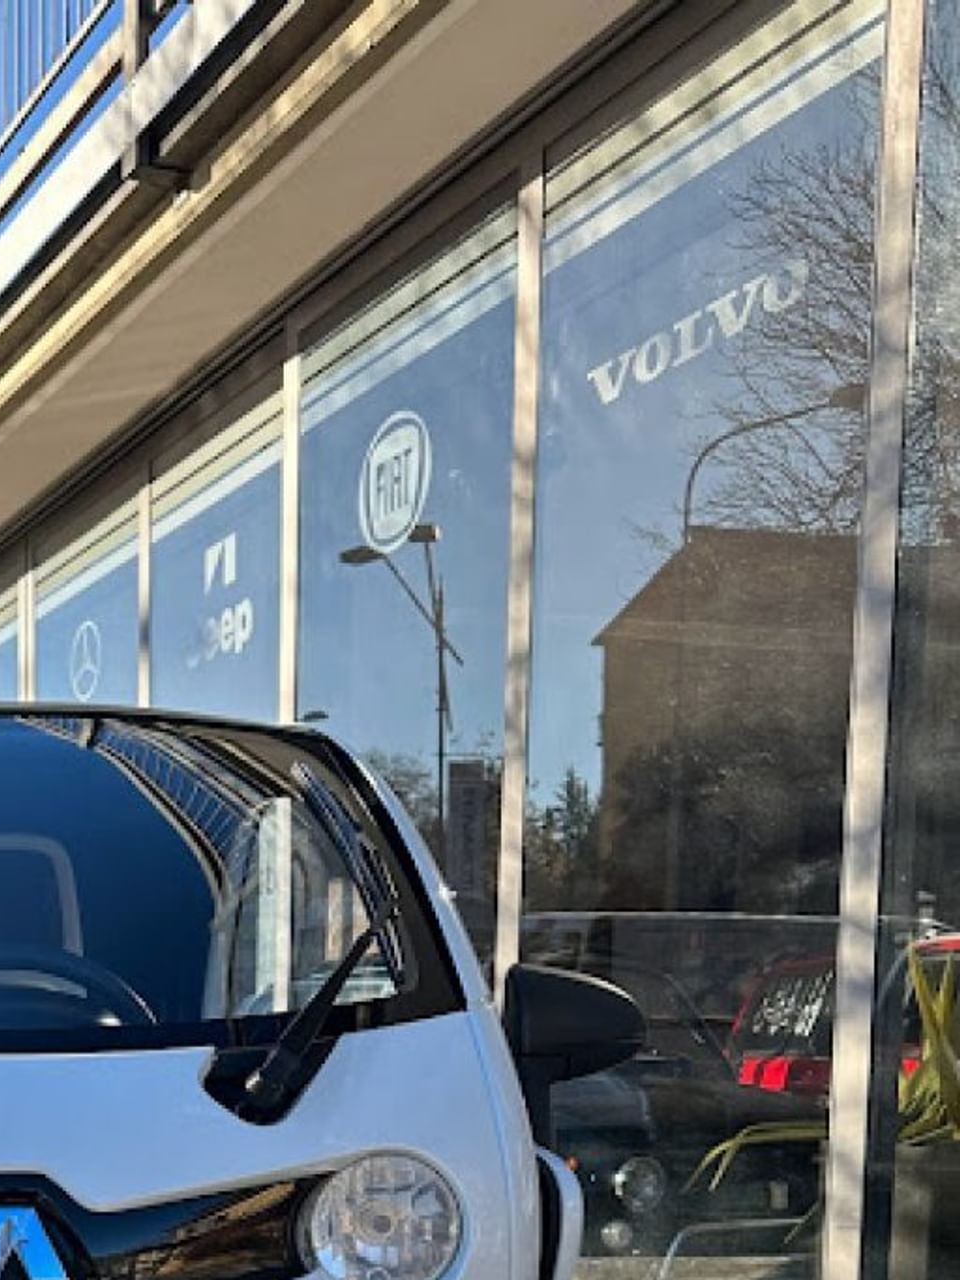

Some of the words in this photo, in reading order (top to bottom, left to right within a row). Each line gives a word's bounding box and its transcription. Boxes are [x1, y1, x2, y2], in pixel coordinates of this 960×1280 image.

[587, 259, 809, 405] VOLVO
[376, 447, 412, 516] FIAT
[186, 597, 253, 668] eep
